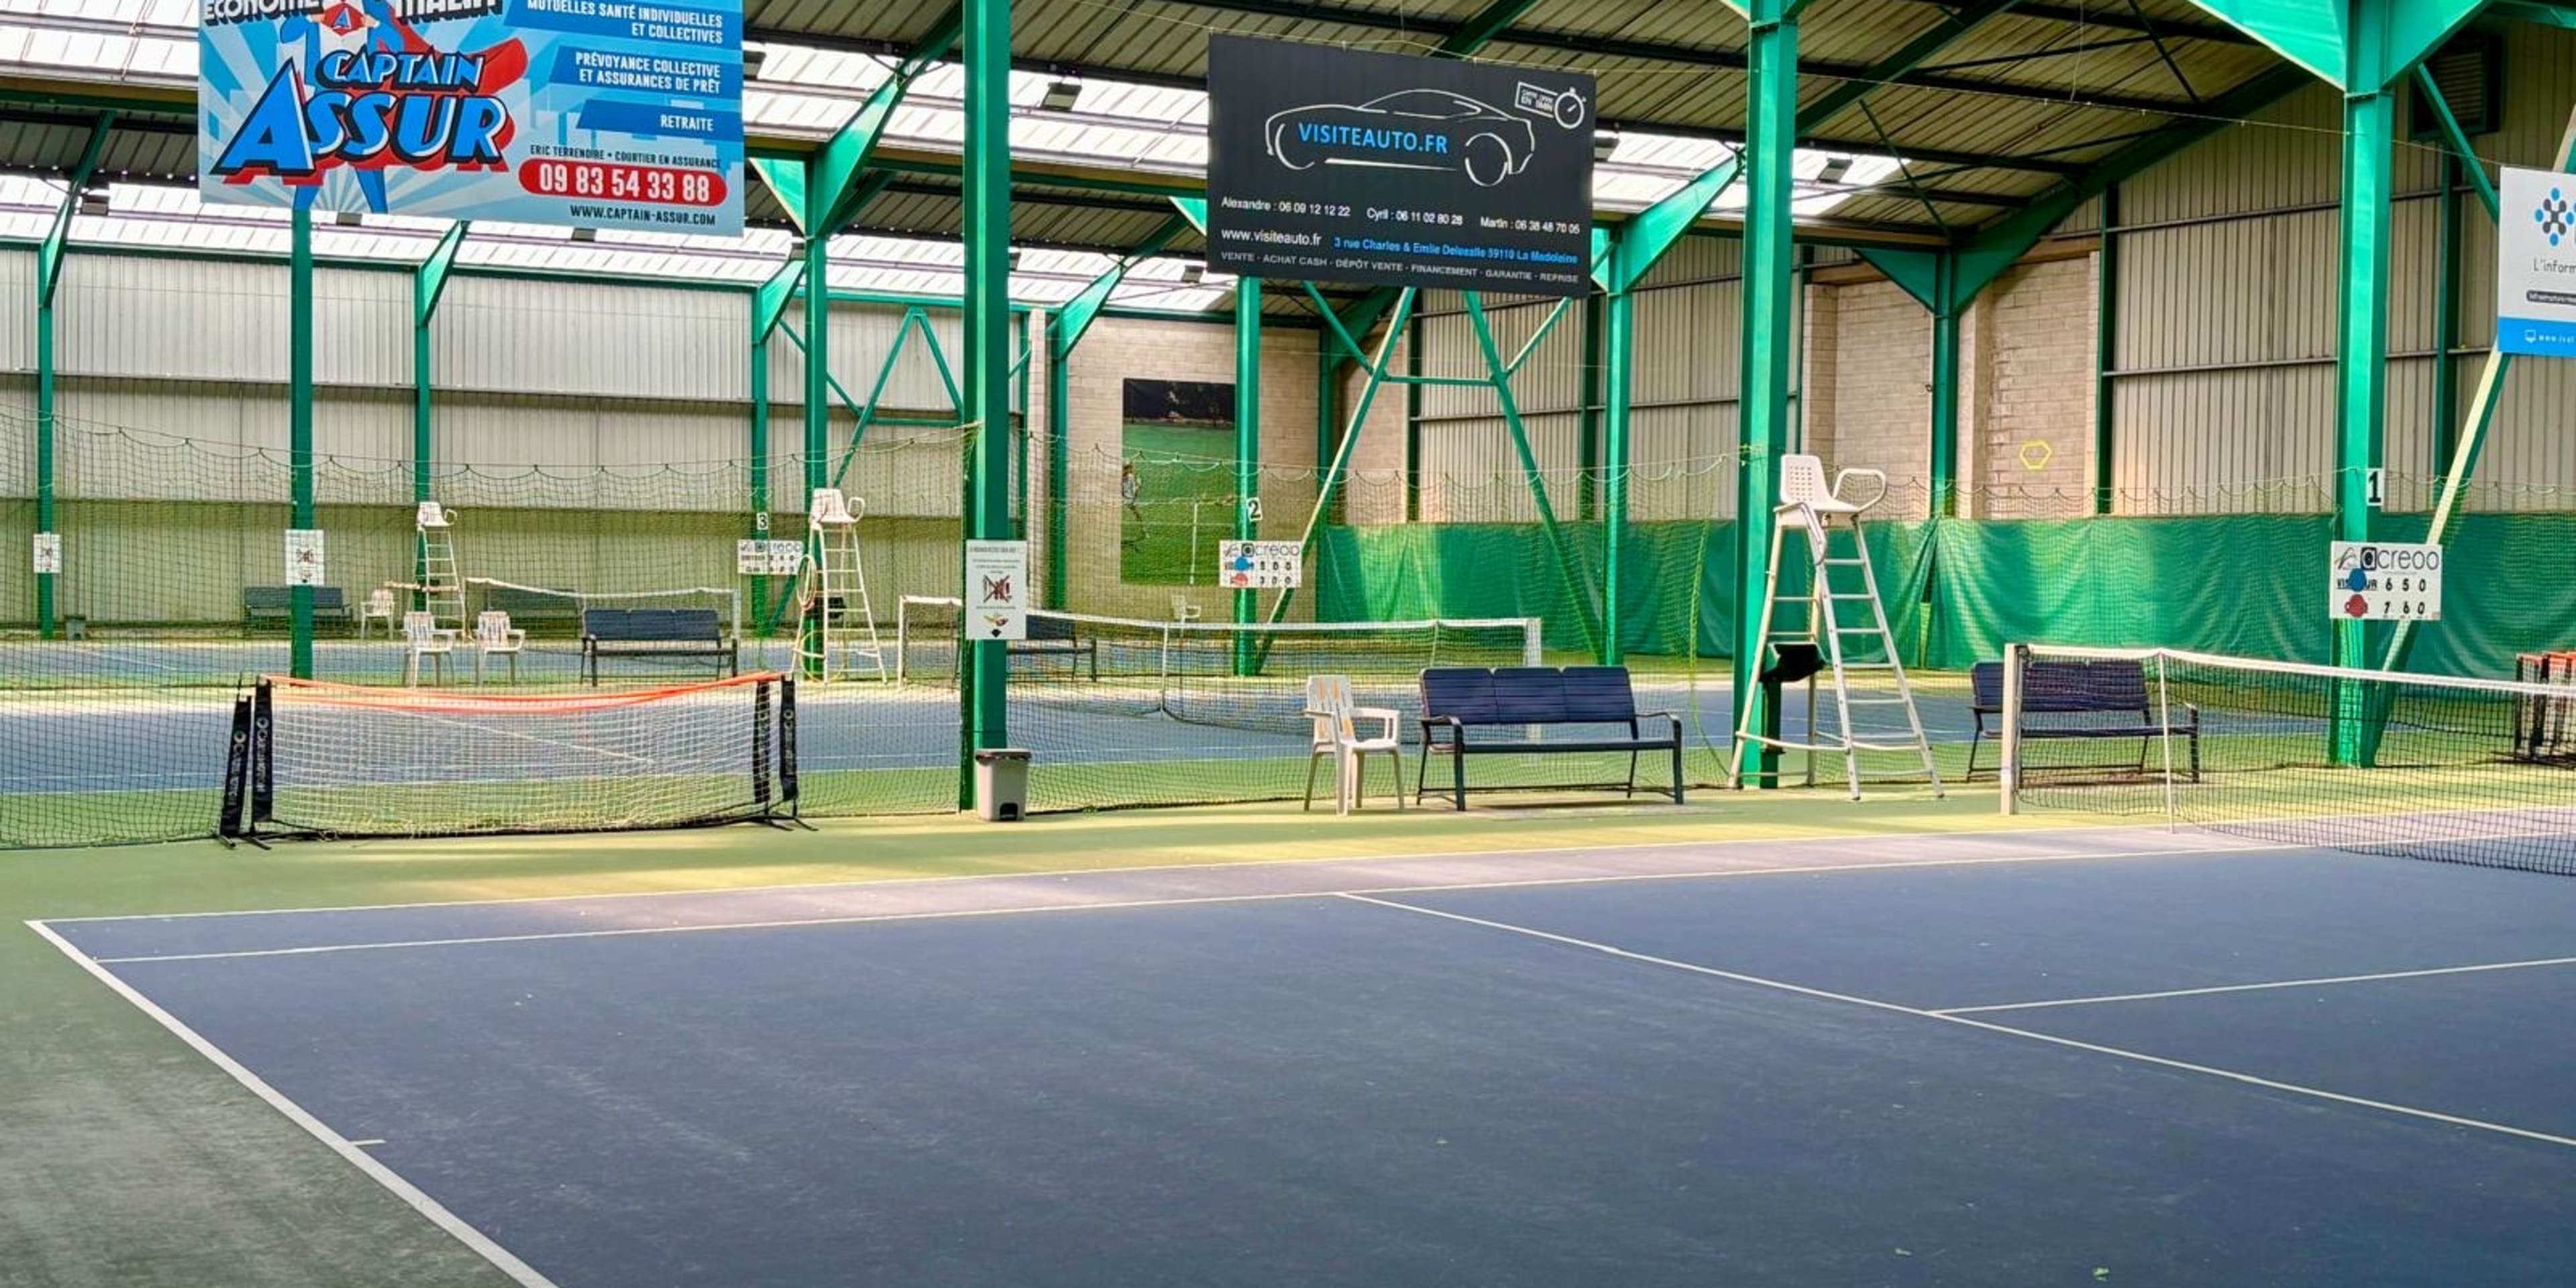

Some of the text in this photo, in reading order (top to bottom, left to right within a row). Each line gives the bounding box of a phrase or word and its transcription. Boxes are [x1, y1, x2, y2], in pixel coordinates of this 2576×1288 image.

[335, 13, 350, 28] A
[527, 0, 722, 28] MUTUELLES SANTÉ INDIVIDUELLES
[631, 22, 722, 44] ET COLLECTIVES
[318, 46, 488, 91] CAPTAIN
[576, 51, 720, 78] PRÉVOYANCE COLLECTIVE
[579, 68, 720, 94] ET ASSURANCES DE PRÊT
[210, 59, 508, 176] ASSUR
[660, 115, 714, 131] RETRAITE
[1298, 122, 1448, 154] VISITEAUTO.FR
[530, 144, 722, 168] ERIC TERRENOIRE COURTIER EN ASSURANCE
[539, 163, 710, 203] 09 83 54 33 88
[570, 205, 716, 226] WWW.CAPTAIN-ASSUR.COM
[1221, 197, 1271, 211] Alexandre
[1279, 201, 1291, 212] 06
[1293, 202, 1306, 213] 09
[1309, 203, 1321, 215] 12
[1324, 205, 1336, 216] 12
[1338, 206, 1350, 217] 22
[1366, 207, 1389, 221] Cyril
[1396, 210, 1408, 221] 06
[1411, 211, 1421, 222] 11
[1423, 212, 1435, 223] 02
[1437, 213, 1450, 225] 80
[1480, 216, 1508, 228] Martin
[1556, 223, 1567, 233] 70
[1221, 228, 1322, 246] www.visiteauto.fr
[1334, 237, 1340, 248] 3
[1343, 239, 1360, 250] rue
[1362, 239, 1400, 252] Charles
[1403, 241, 1411, 252] &
[1517, 249, 1529, 260] La
[1221, 252, 1255, 262] VENTE
[1263, 254, 1296, 264] ACHAT
[1299, 256, 1327, 267] CASH
[1335, 257, 1368, 269] DÉPÔT
[1371, 261, 1403, 272] VENTE
[1411, 264, 1477, 276] FINANCEMENT
[1485, 270, 1532, 280] GARANTIE
[1540, 272, 1578, 284] REPRISE
[2367, 470, 2382, 503] 1
[1248, 500, 1261, 519] 2
[759, 514, 767, 529] 3
[2385, 578, 2393, 592] 6
[2402, 578, 2410, 592] 5
[2418, 578, 2426, 592] 0
[2383, 600, 2391, 614] 7
[2403, 600, 2410, 614] 6
[2418, 601, 2426, 614] 0
